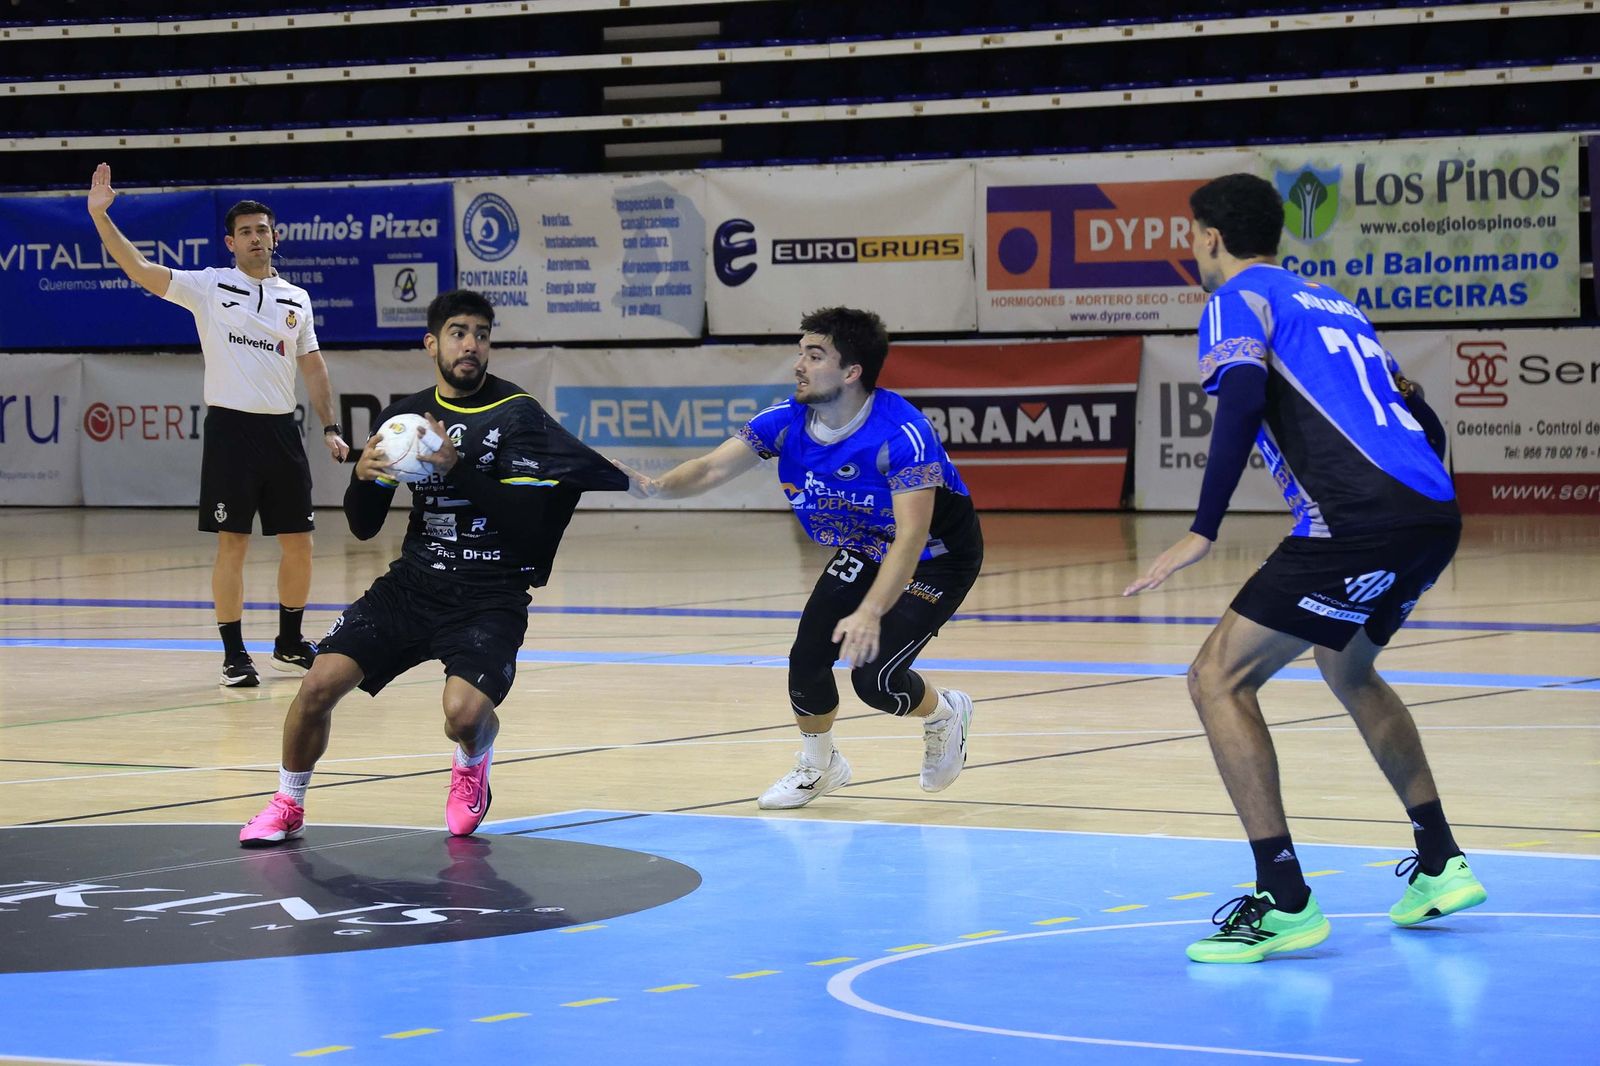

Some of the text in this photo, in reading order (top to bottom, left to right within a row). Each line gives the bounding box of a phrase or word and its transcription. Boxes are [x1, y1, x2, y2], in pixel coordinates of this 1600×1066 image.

[1355, 158, 1561, 206] Los Pinos
[616, 196, 674, 212] Inspección de
[279, 214, 363, 241] omino's
[370, 212, 438, 239] Pizza
[621, 216, 679, 230] canalizaciones
[1090, 216, 1191, 251] DYPR
[1360, 214, 1557, 235] www.colegiolospinos.eu
[544, 236, 599, 249] Instalaciones.
[623, 238, 637, 249] con
[775, 239, 959, 262] EUROGRUAS
[1281, 249, 1559, 279] Con el Balonmano
[39, 277, 97, 291] Queremos
[100, 276, 129, 289] verte
[460, 265, 528, 286] FONTANERÍA
[546, 281, 575, 296] Energía
[1355, 282, 1528, 310] ALGECIRAS
[991, 296, 1065, 307] HORMIGONES
[1076, 293, 1132, 306] MORTERO
[1137, 293, 1168, 305] SECO
[1070, 309, 1160, 324] www.dypre.com
[229, 332, 274, 351] helvetia
[588, 396, 783, 438] REMES
[1160, 382, 1213, 438] IB
[921, 402, 1117, 444] BRAMAT
[1456, 420, 1521, 436] Geotecnia
[1536, 419, 1582, 436] Control
[1160, 444, 1266, 469] Enea
[1559, 447, 1573, 459] 00
[1492, 483, 1600, 502] www.ser
[826, 549, 864, 583] 23
